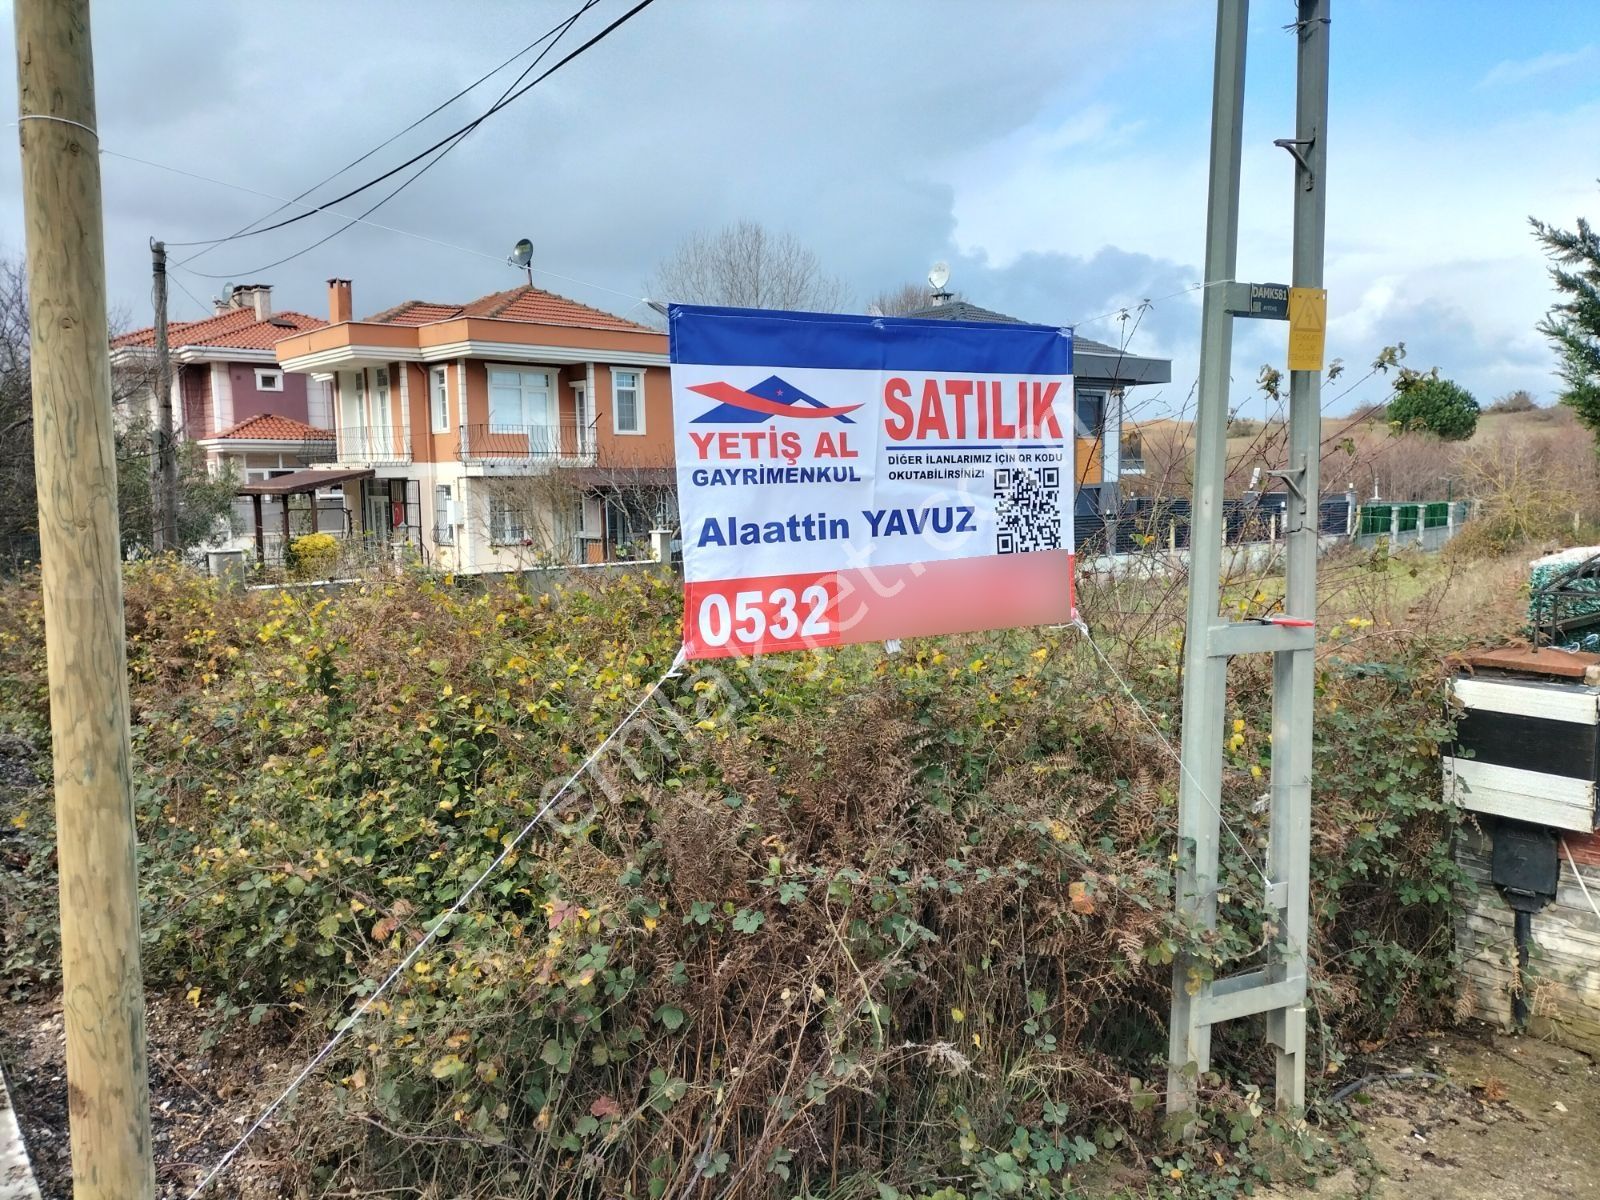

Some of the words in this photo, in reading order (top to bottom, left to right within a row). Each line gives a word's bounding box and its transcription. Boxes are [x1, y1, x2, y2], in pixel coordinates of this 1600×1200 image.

[1251, 286, 1288, 300] DAMK581
[884, 378, 1063, 441] SATILIK
[689, 426, 801, 466] YETİŞ
[814, 431, 859, 457] AL
[888, 453, 923, 465] DİĞER
[926, 453, 992, 464] İLANLARIMIZ
[1035, 452, 1062, 462] KODU
[692, 464, 861, 487] GAYRİMENKUL
[697, 512, 850, 547] Alaattin
[862, 506, 977, 537] YAVUZ
[698, 586, 829, 646] 0532
